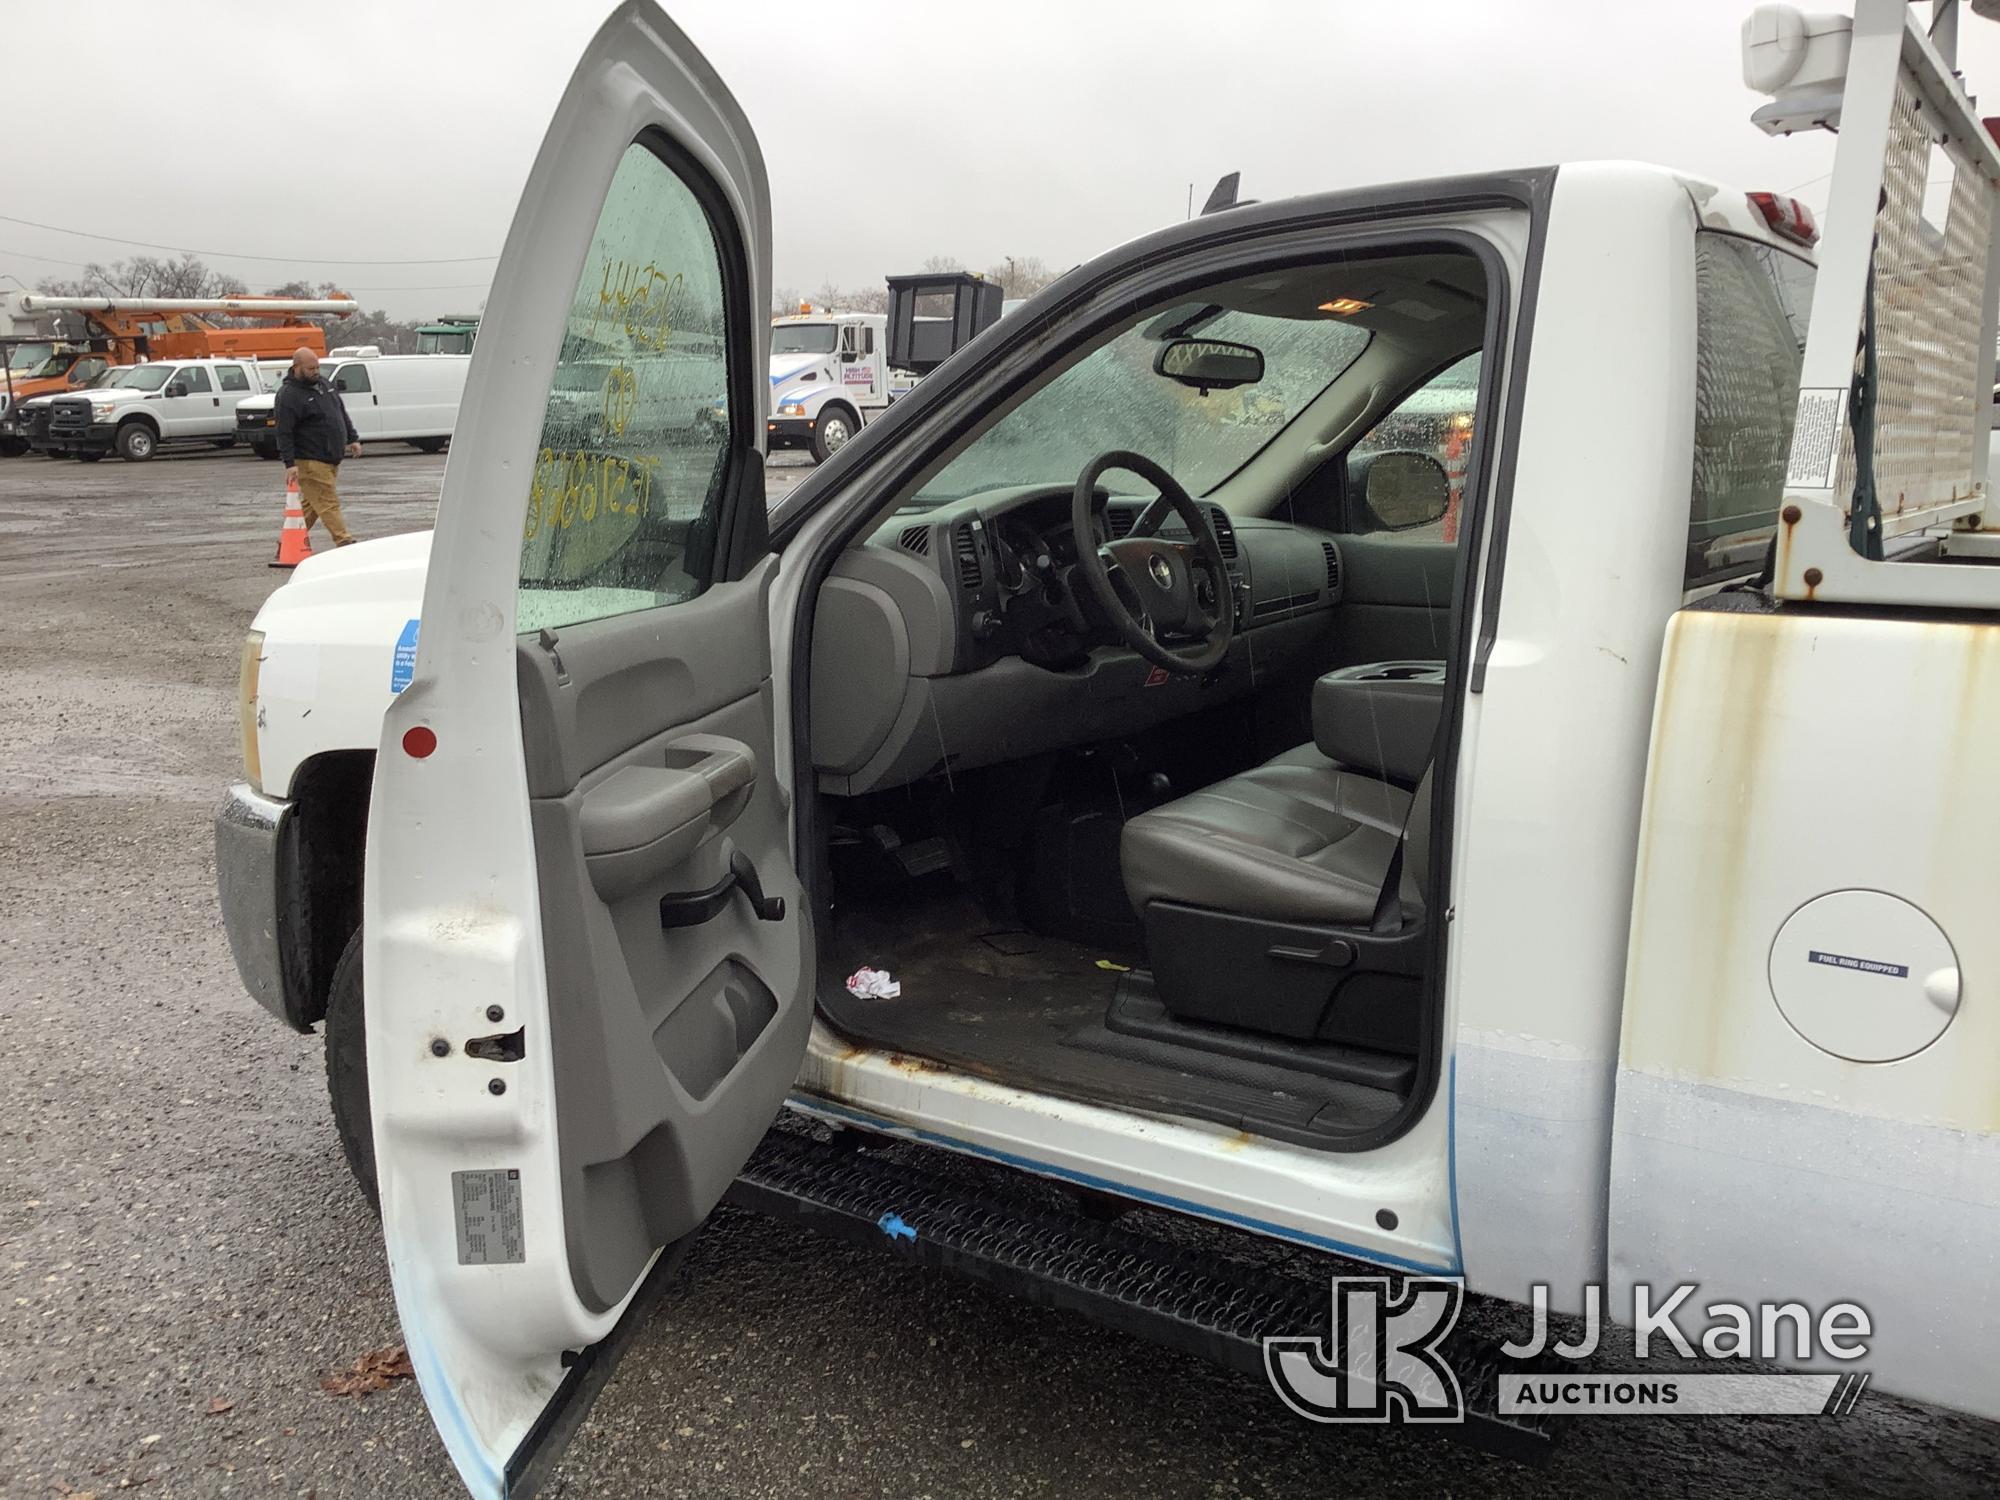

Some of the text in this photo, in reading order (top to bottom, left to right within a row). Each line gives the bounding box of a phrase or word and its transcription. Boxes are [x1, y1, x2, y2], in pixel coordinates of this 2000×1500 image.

[1818, 954, 1899, 974] FUEL RING EQUIPPED
